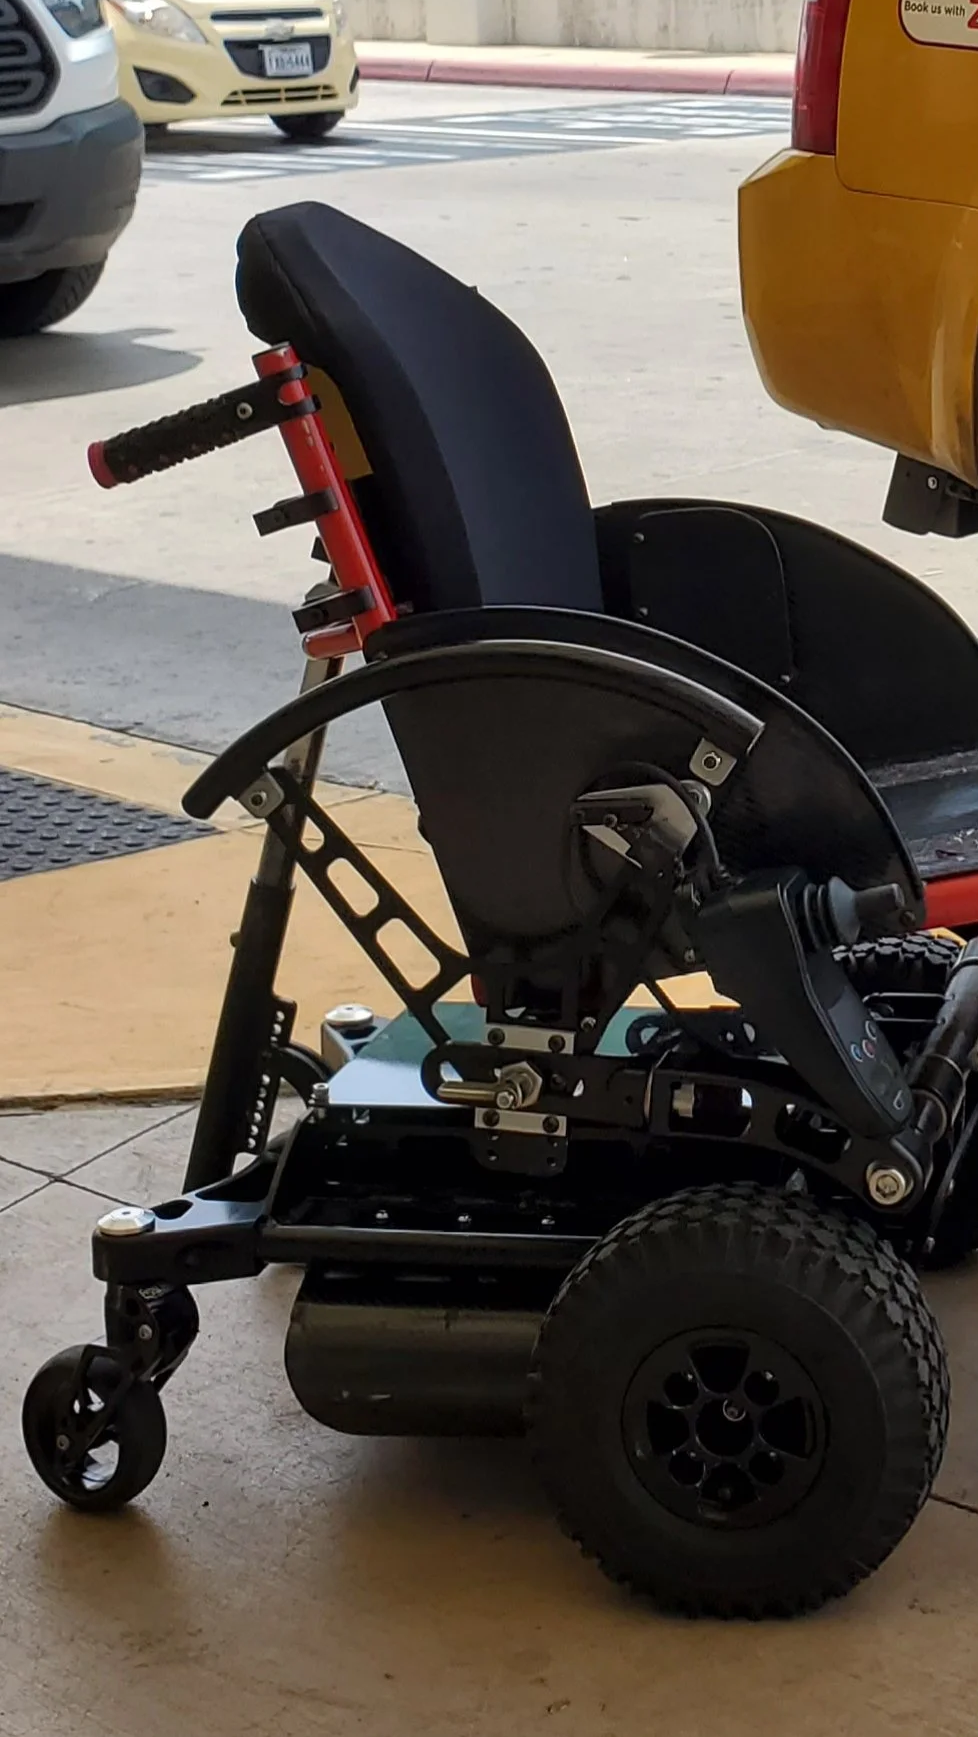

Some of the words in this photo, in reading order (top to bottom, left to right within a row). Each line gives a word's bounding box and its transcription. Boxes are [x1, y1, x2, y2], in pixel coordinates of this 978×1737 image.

[904, 0, 929, 13] Book
[930, 4, 942, 14] us
[944, 4, 966, 17] with
